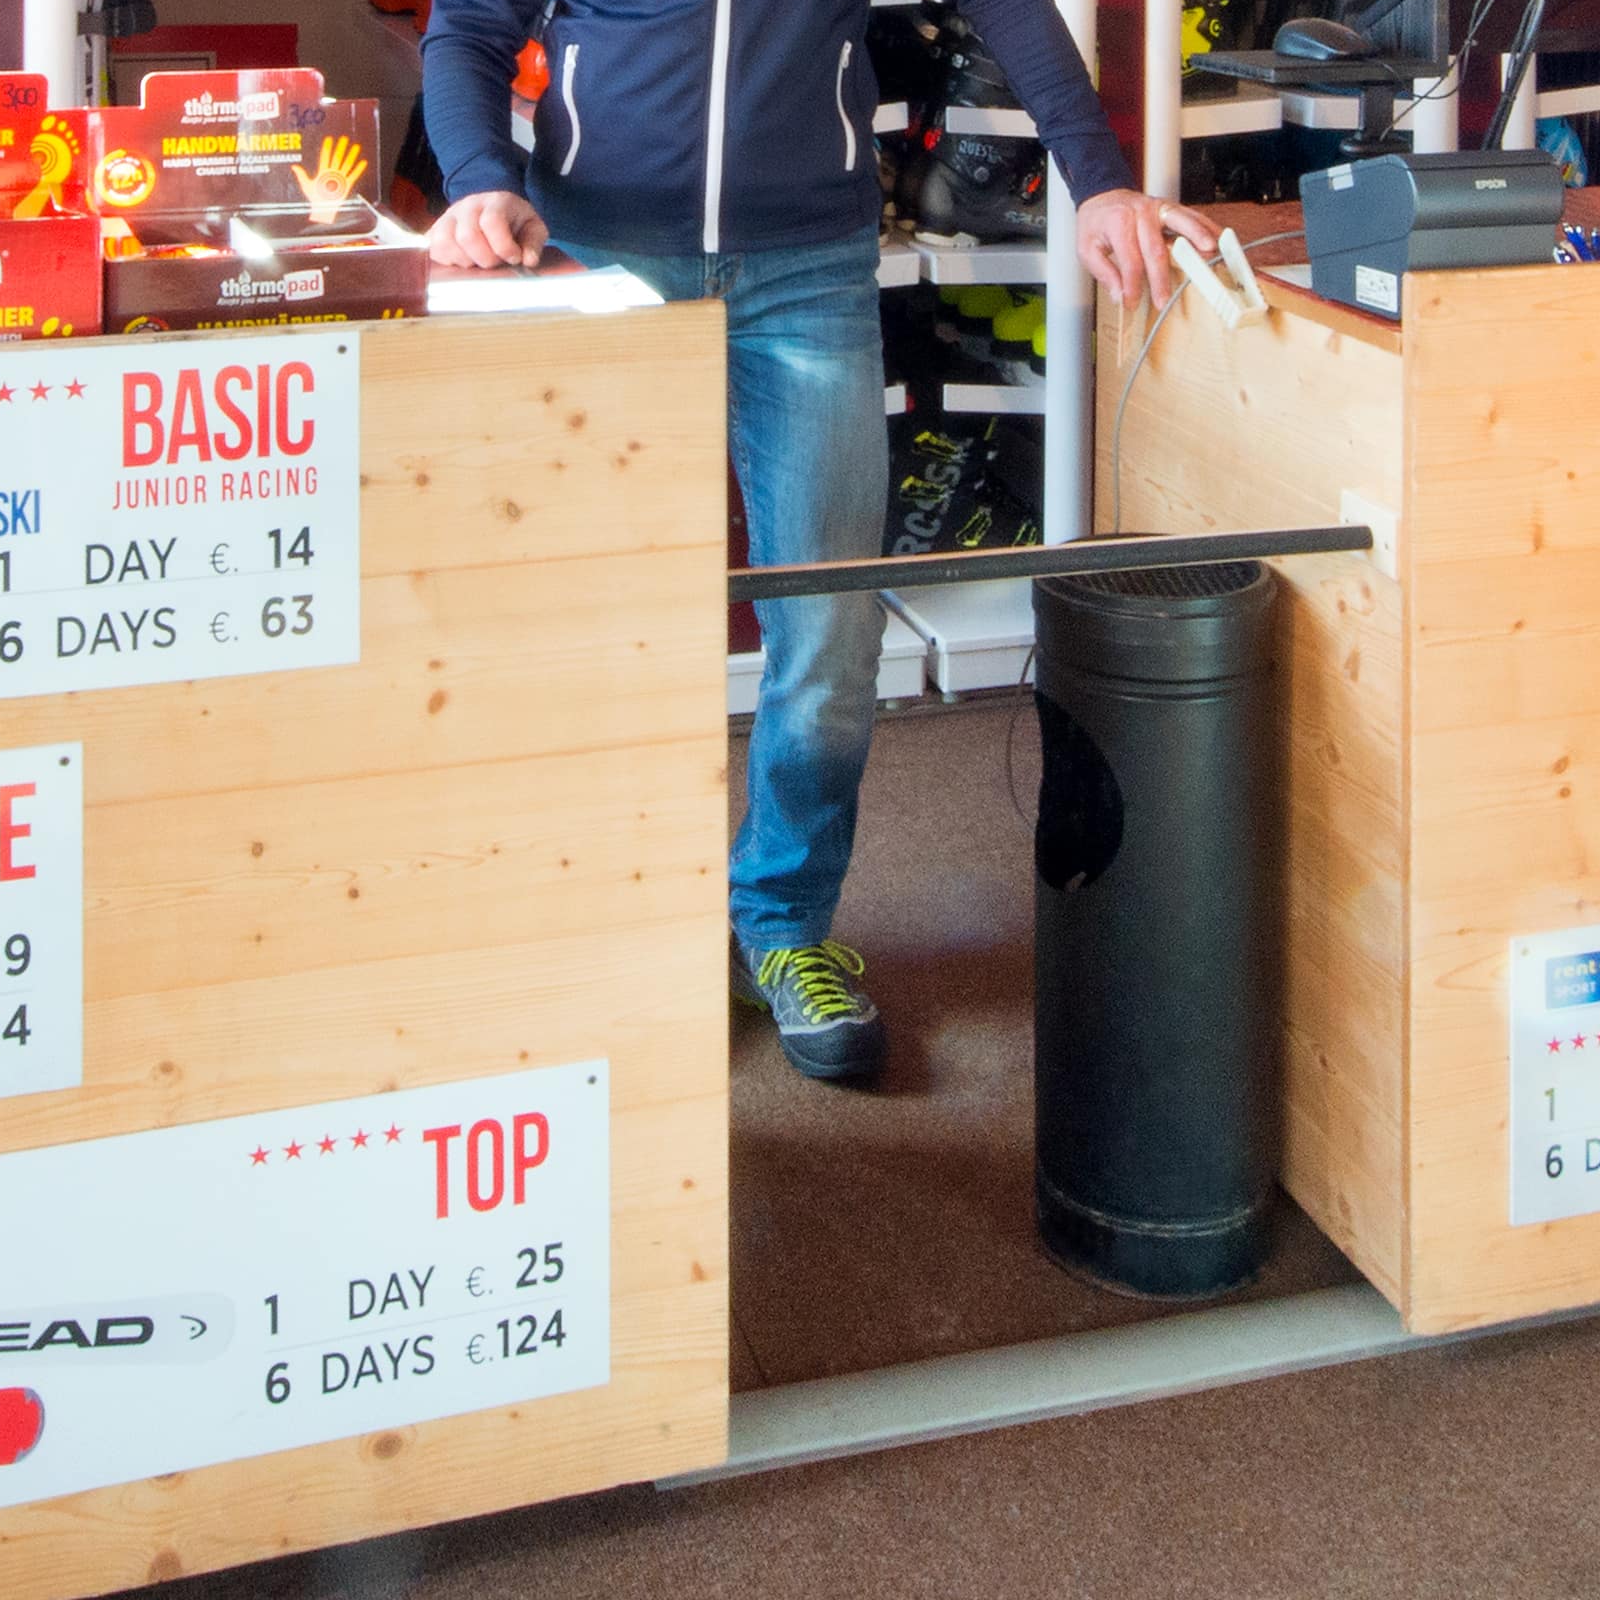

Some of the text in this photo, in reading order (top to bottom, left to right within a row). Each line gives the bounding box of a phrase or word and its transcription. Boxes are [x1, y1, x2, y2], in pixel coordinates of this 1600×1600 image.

[162, 131, 303, 156] HANDWÄRMER
[162, 158, 192, 169] HAND
[192, 156, 236, 167] WARMER
[1474, 178, 1507, 190] EPSON
[219, 269, 324, 301] thermopad
[122, 361, 316, 471] BASIC
[116, 467, 317, 508] JUNIOR RACING
[85, 537, 177, 586] DAY
[267, 526, 315, 569] 14
[56, 606, 177, 659] DAYS
[261, 594, 314, 638] 63
[1545, 1088, 1555, 1121] 1
[422, 1111, 550, 1219] TOP
[1545, 1144, 1564, 1179] 6
[263, 1293, 279, 1336] 1
[348, 1265, 435, 1321] DAY
[515, 1241, 565, 1289] 25
[265, 1361, 291, 1405] 6
[321, 1345, 435, 1395] DAYS
